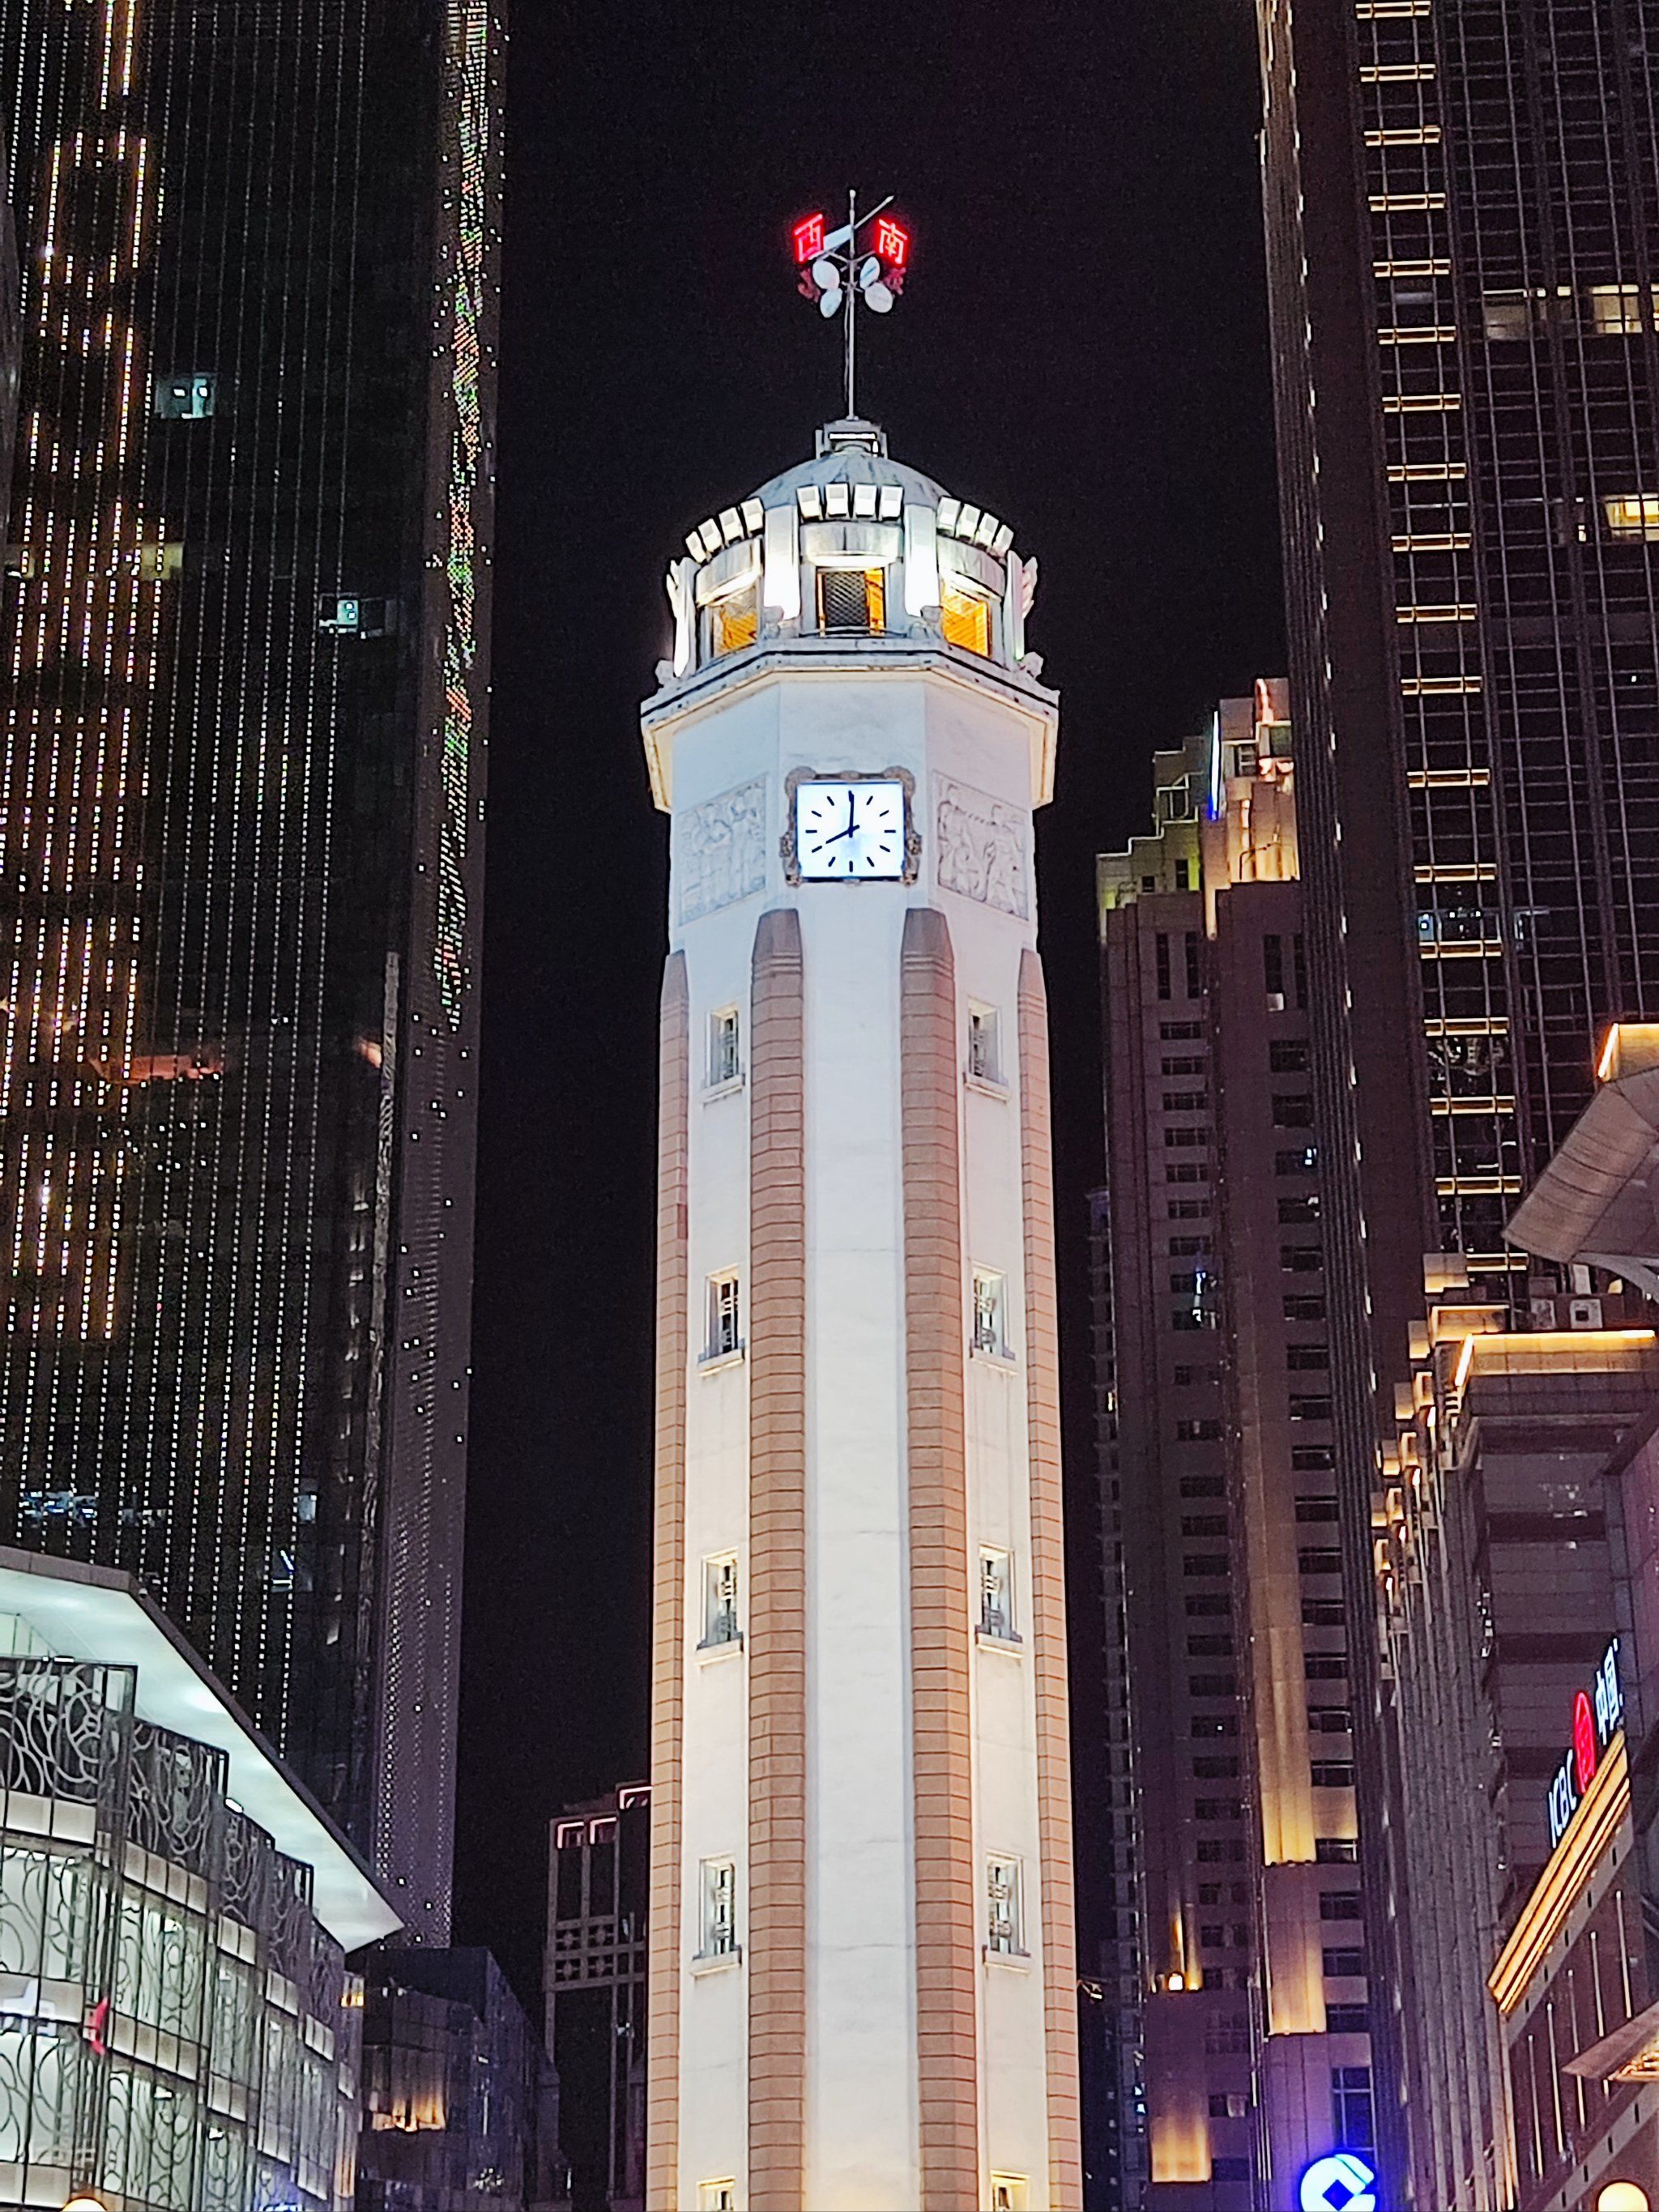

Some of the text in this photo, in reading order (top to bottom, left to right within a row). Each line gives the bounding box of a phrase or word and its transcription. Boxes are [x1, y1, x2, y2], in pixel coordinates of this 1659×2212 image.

[794, 214, 823, 262] 西
[878, 219, 907, 264] 南
[1595, 1638, 1624, 1745] 中国
[1548, 1749, 1577, 1849] ICBC
